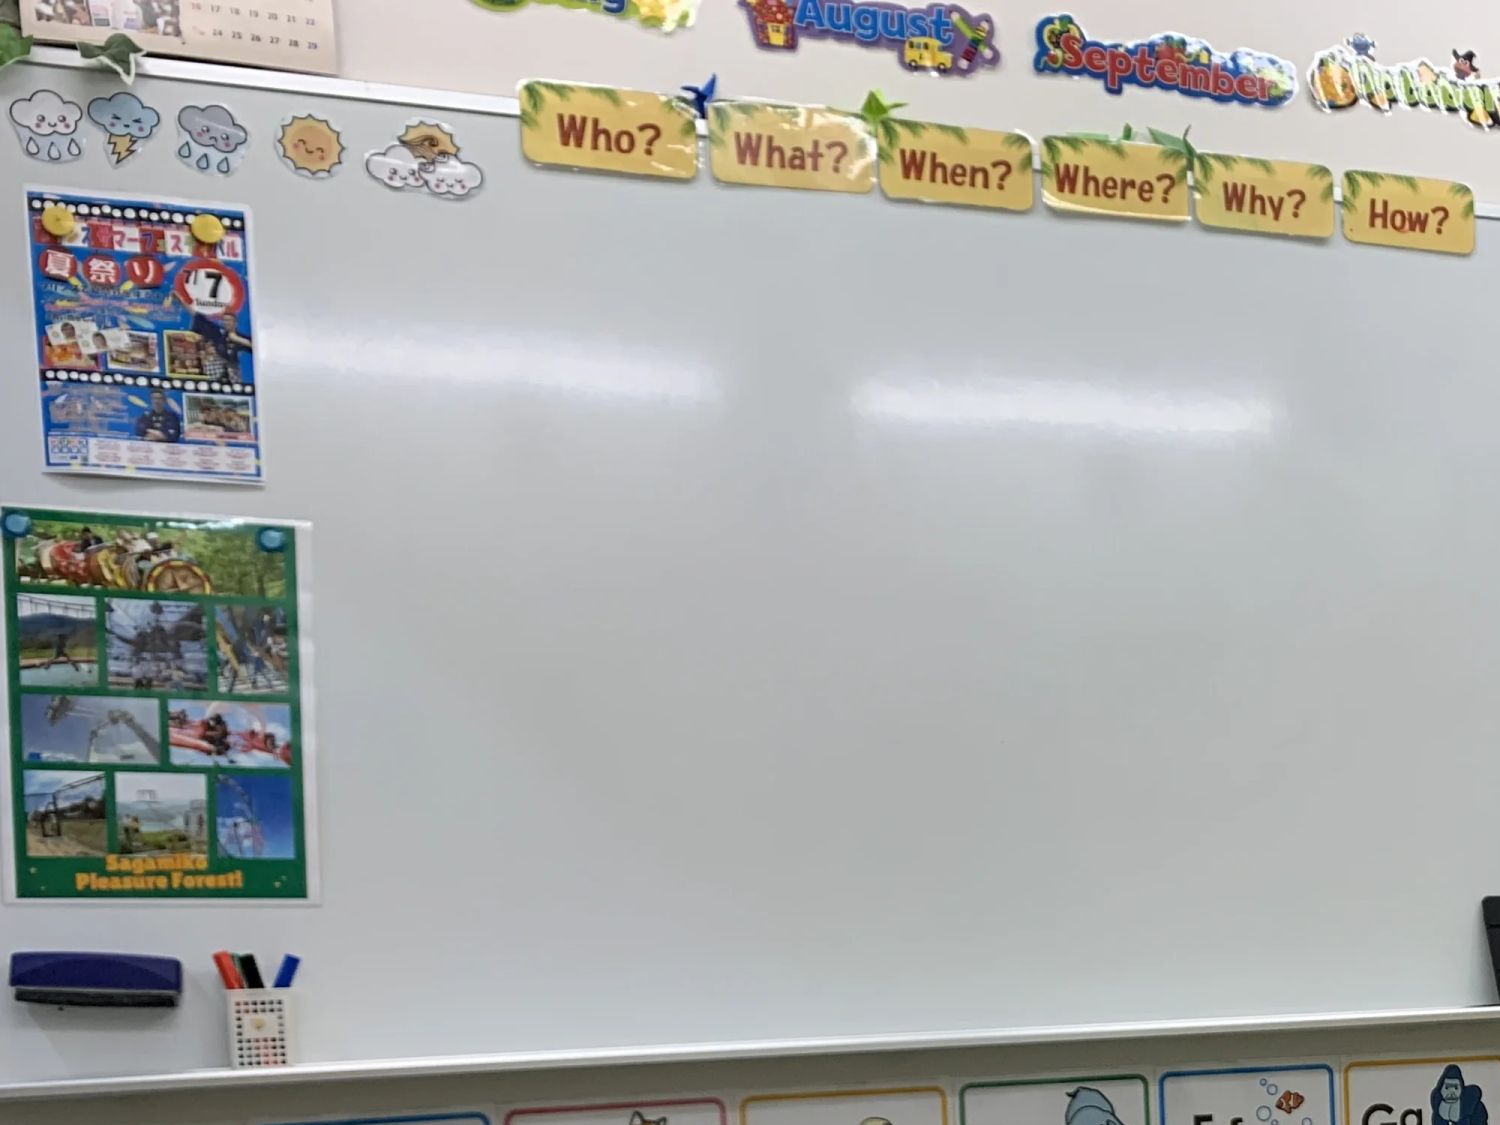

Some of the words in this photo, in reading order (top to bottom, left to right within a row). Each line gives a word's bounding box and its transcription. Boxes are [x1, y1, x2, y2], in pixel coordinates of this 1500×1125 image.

[794, 0, 954, 45] August
[1045, 33, 1277, 102] September
[556, 112, 662, 155] Who?
[734, 132, 848, 173] What?
[899, 148, 1014, 191] When?
[1054, 162, 1176, 204] Where?
[1221, 181, 1308, 222] Why?
[1367, 198, 1450, 237] How?
[75, 872, 168, 891] Pleasure
[171, 870, 244, 890] Forest!
[105, 853, 209, 874] Sagamiko
